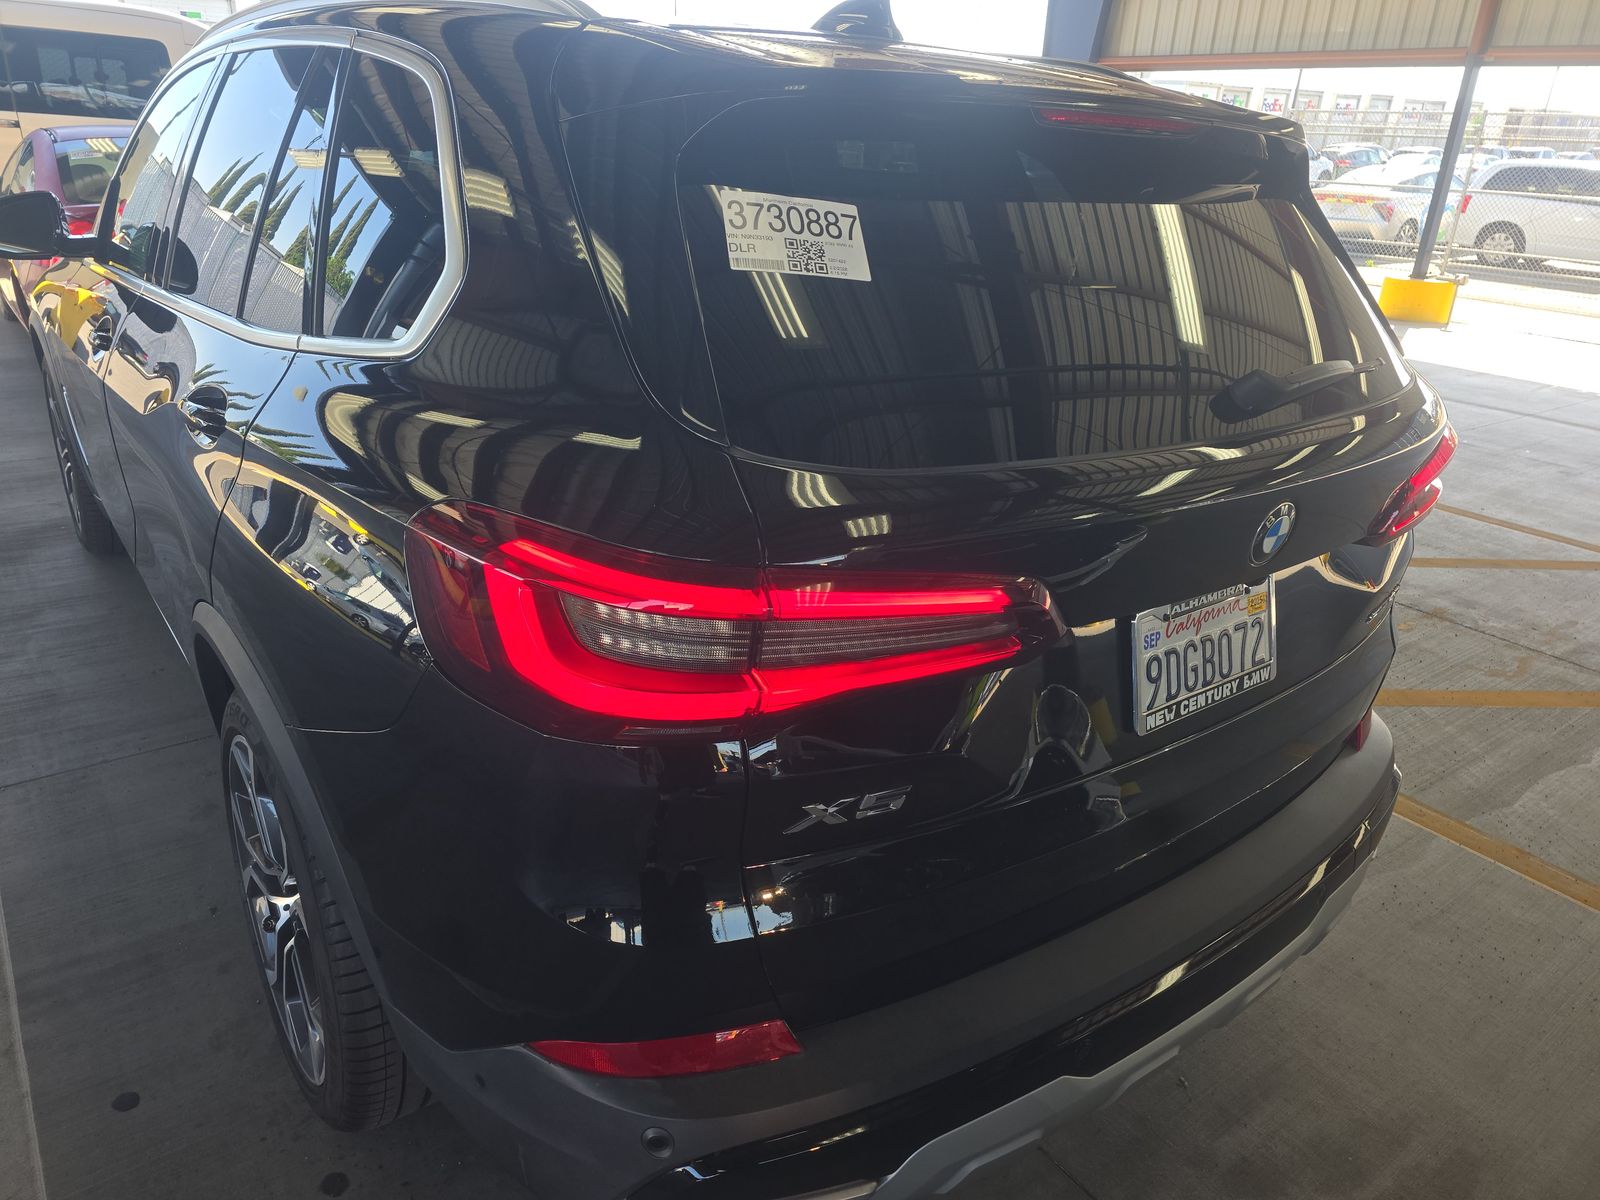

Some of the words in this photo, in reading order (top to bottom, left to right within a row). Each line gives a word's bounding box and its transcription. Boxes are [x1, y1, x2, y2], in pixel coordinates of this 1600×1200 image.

[1261, 98, 1283, 112] FedEx
[727, 199, 857, 241] 3730887
[729, 243, 757, 253] DLR
[1165, 598, 1248, 639] California
[1171, 583, 1244, 615] ALHAMBRA
[1143, 631, 1161, 651] SEP
[1145, 617, 1266, 711] 9DGB072
[1146, 706, 1176, 730] NEW
[1180, 678, 1240, 716] CENTURY
[783, 785, 913, 835] X5
